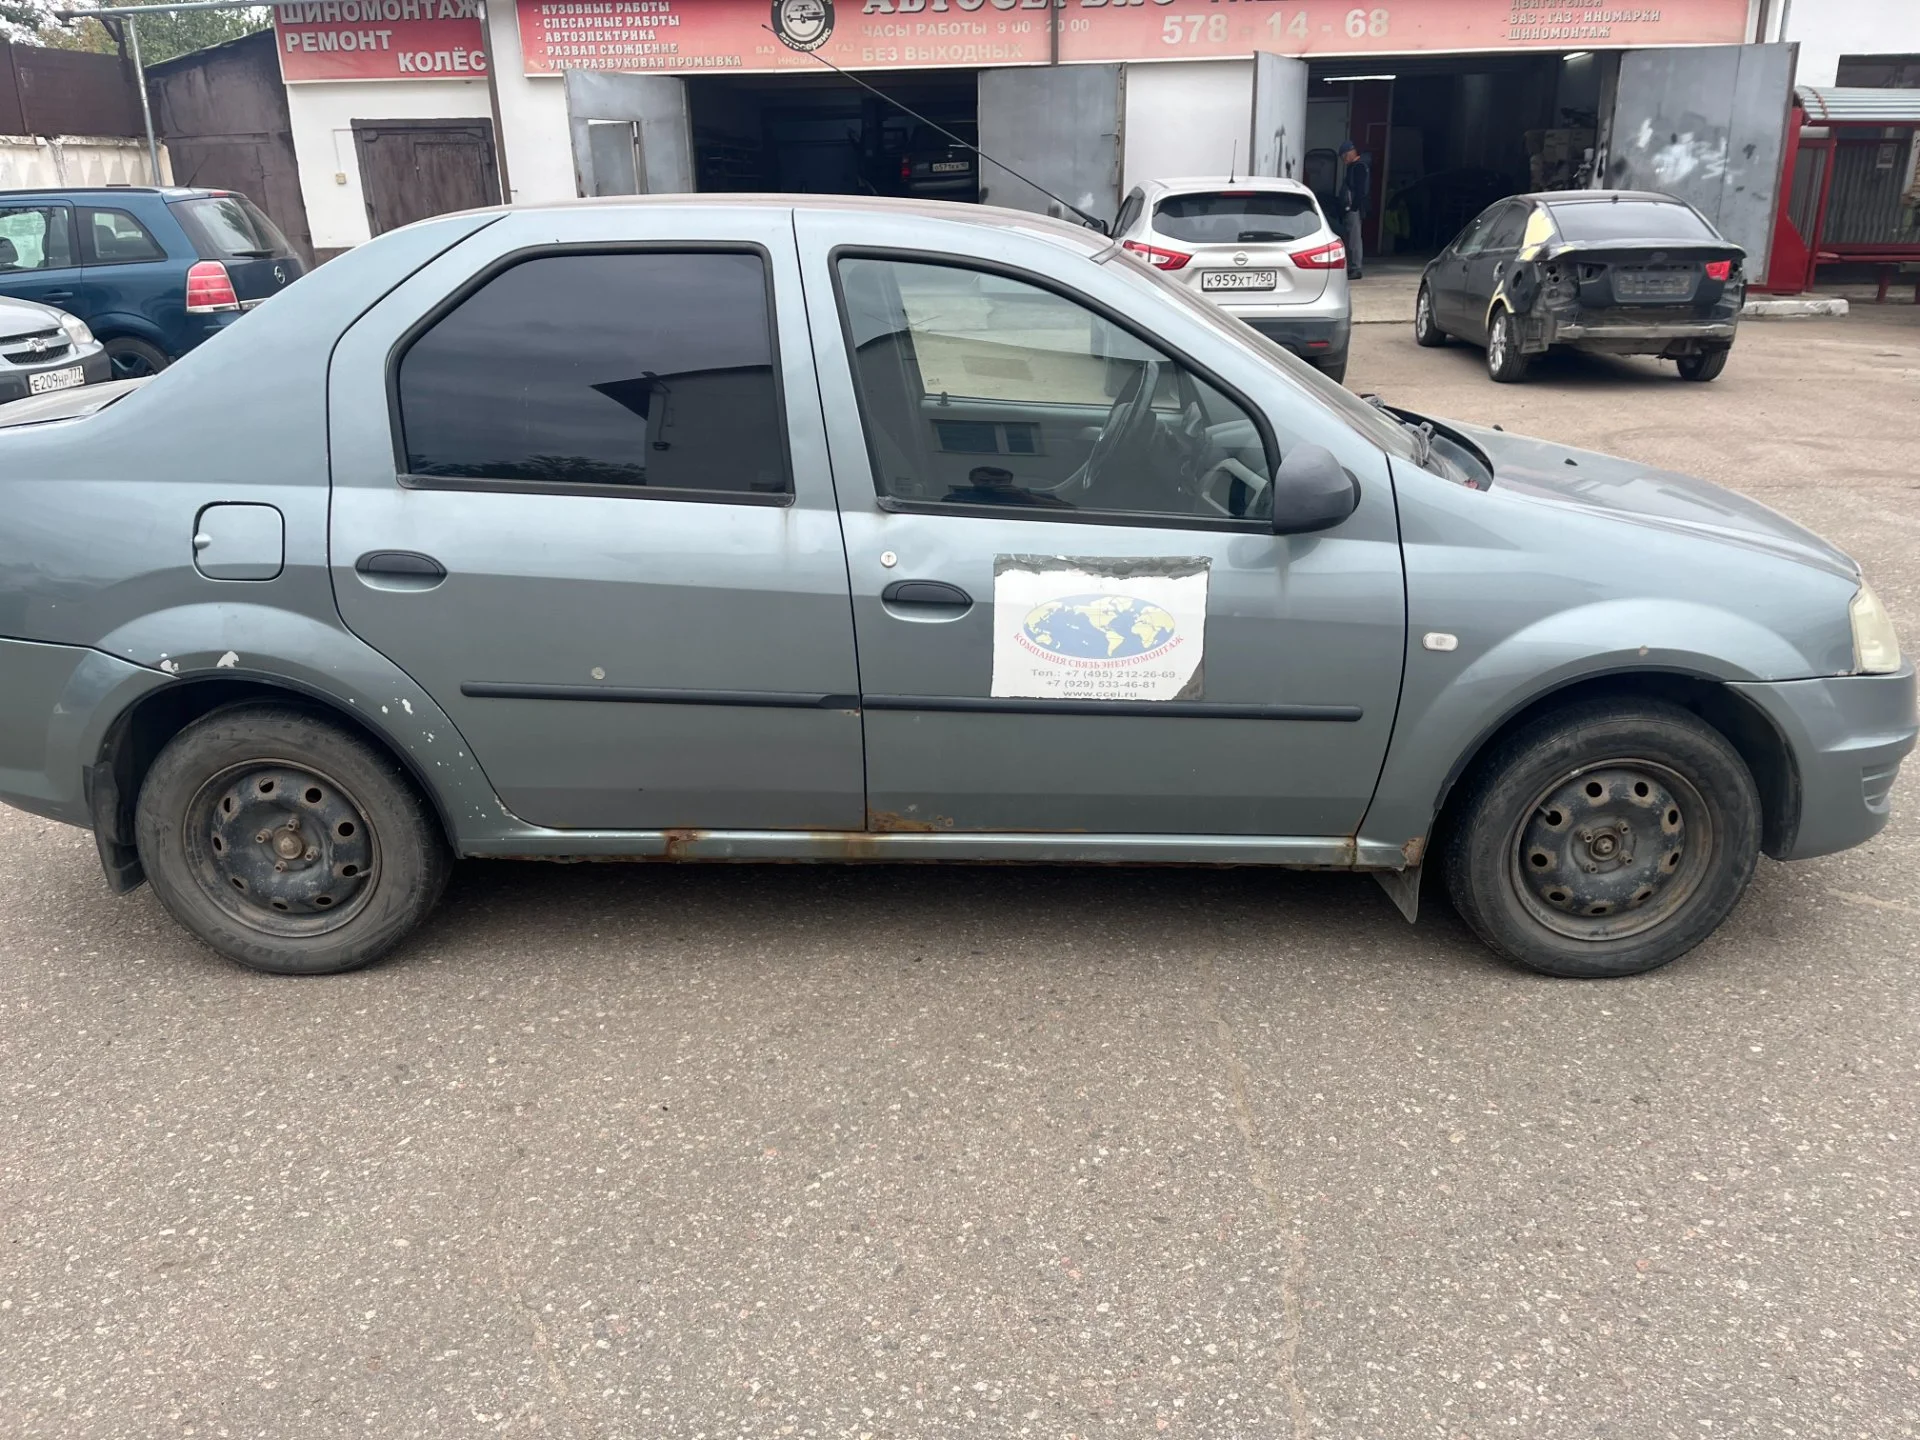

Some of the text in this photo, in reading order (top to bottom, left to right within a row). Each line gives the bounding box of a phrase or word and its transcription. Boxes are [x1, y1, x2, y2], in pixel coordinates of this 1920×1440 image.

[542, 1, 670, 15] КУЗОВНЫЕ РАБОТЫ
[543, 15, 680, 29] СЛЕСАРНЫЕ РАБОТЫ
[1583, 10, 1661, 23] ИНОМАРКИ
[862, 23, 910, 37] ЧАСЫ
[916, 21, 987, 36] РАБОТЫ
[1161, 14, 1229, 44] 578
[1265, 11, 1309, 41] 14
[1344, 8, 1390, 39] 68
[1508, 26, 1611, 40] ШИНОМОНТАЖ
[285, 30, 393, 52] РЕМОНТ
[545, 29, 656, 43] АВТОЭЛЕКТРИКА
[547, 43, 679, 56] РАЗВАЛ СХОЖДЕНИЕ
[861, 43, 1024, 62] БЕЗ ВЫХОДНЫХ
[398, 46, 487, 72] КОЛЁС
[548, 55, 742, 71] УЛЬТРАЗВУКОВАЯ ПРОМЫВКА
[1013, 632, 1067, 665] КОМПАНИЯ
[1084, 669, 1113, 679] (495)
[1117, 671, 1176, 679] 212-26-69
[1065, 680, 1094, 689] (929)
[1098, 680, 1156, 689] 533-46-81
